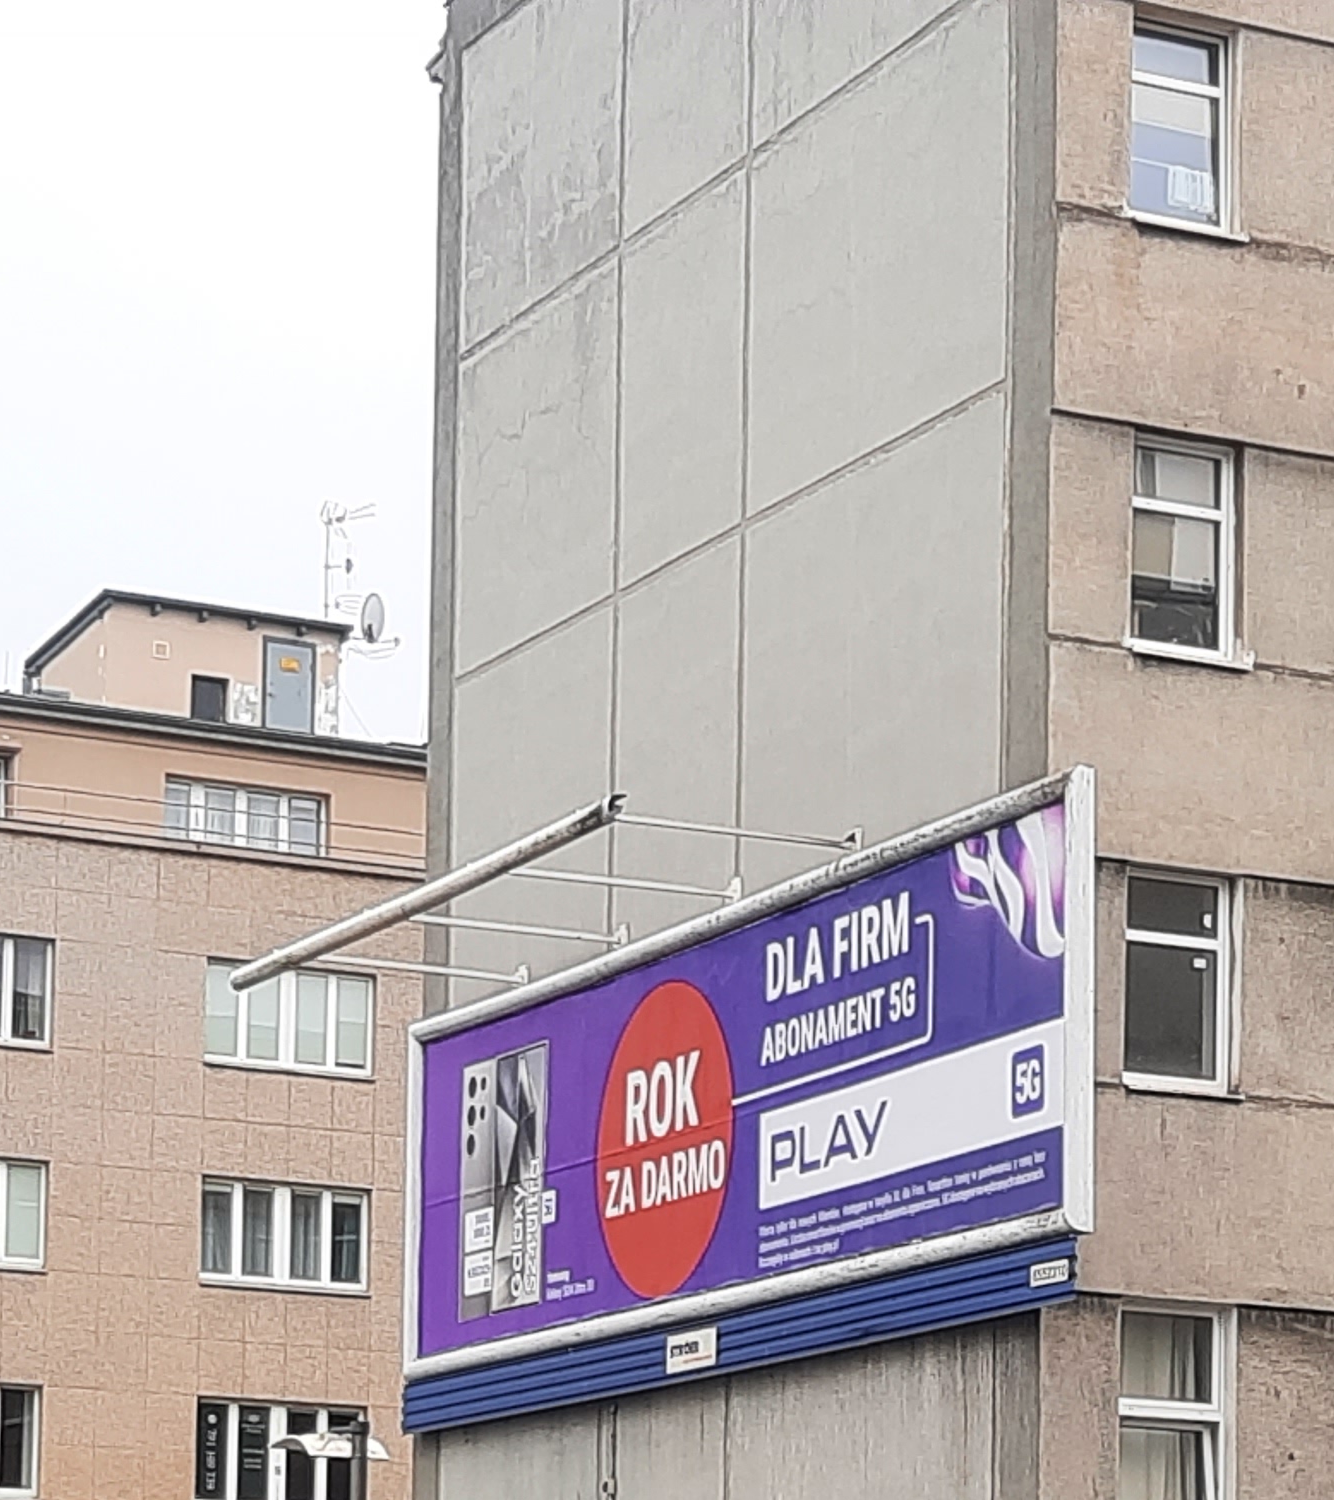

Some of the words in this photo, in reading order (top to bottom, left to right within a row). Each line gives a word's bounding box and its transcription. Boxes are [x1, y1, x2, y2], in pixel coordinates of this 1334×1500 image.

[766, 926, 824, 1002] DLA
[833, 891, 910, 979] FIRM
[760, 987, 885, 1067] ABONAMENT
[889, 976, 916, 1022] 5G
[625, 1050, 701, 1147] ROK
[1015, 1058, 1041, 1105] 5G
[604, 1166, 636, 1219] ZA
[641, 1139, 727, 1210] DARMO
[770, 1100, 888, 1182] PLAY
[510, 1184, 528, 1298] Galaxy
